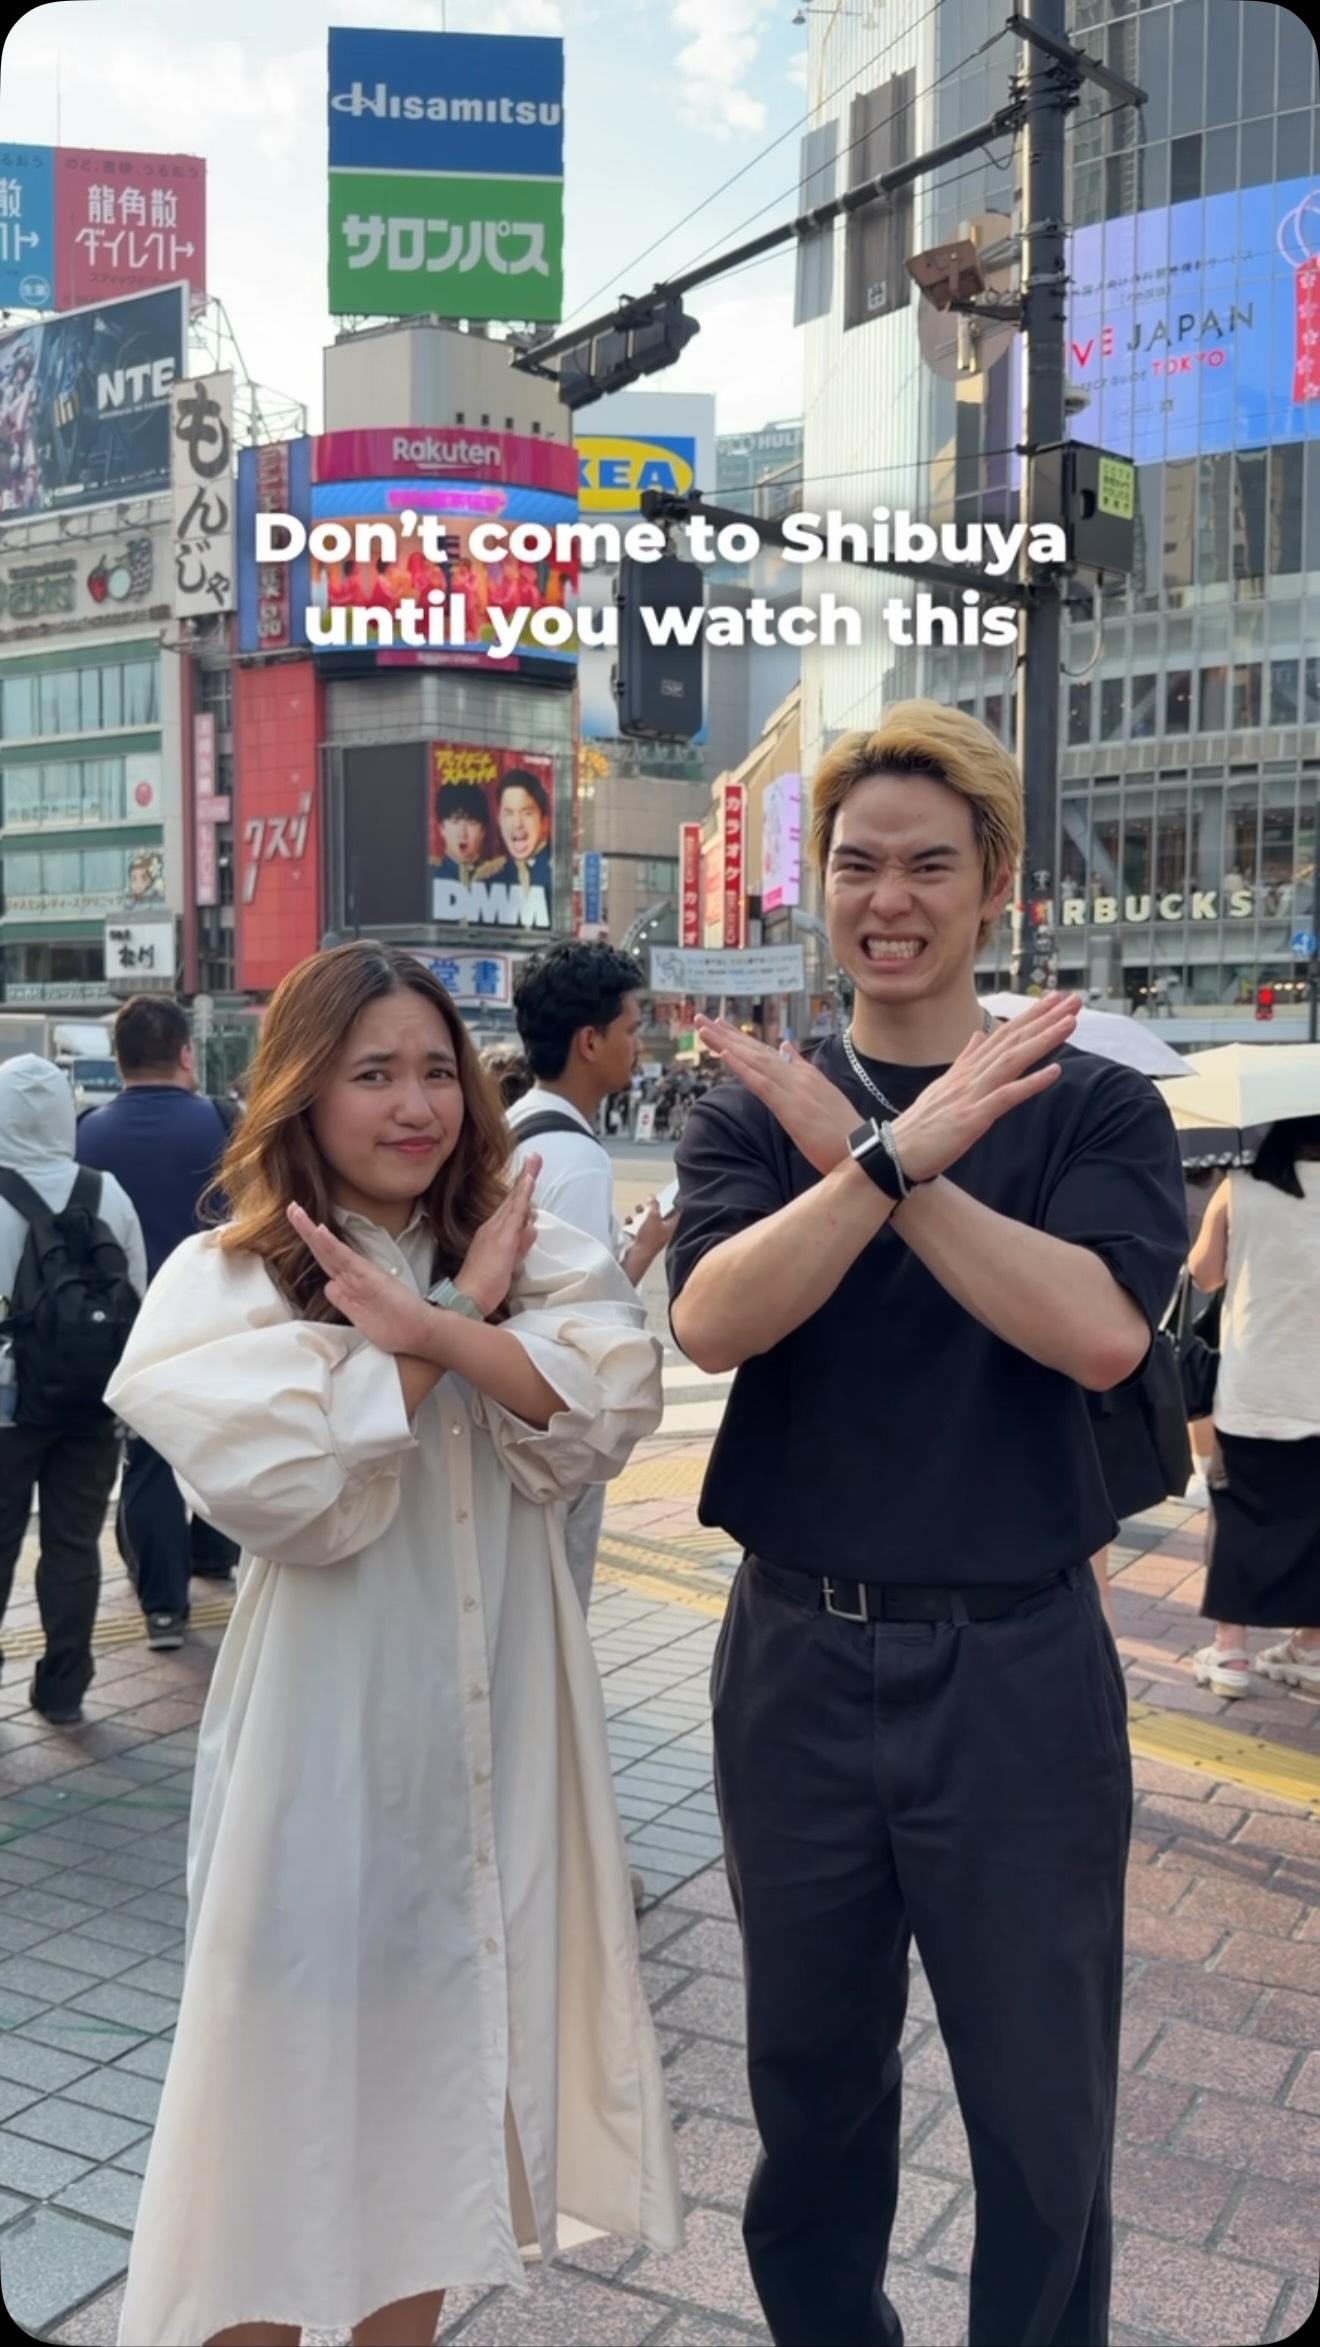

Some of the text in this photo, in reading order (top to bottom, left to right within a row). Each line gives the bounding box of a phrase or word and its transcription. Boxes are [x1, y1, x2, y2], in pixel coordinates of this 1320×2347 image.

[331, 82, 560, 125] Hisamitsu
[87, 184, 178, 228] 龍角散
[75, 227, 196, 272] ダイレクト
[342, 214, 549, 277] サロンパス
[1072, 302, 1254, 368] VE JAPAN
[97, 356, 175, 412] NTE
[1152, 350, 1225, 377] TOKYO
[392, 436, 502, 468] Rakuten
[174, 380, 231, 607] もんじゃ
[242, 791, 313, 903] クスリ
[725, 796, 740, 882] カラオケ
[432, 877, 551, 929] DMM
[684, 890, 698, 945] カラオ
[1062, 890, 1253, 926] RBUCKS
